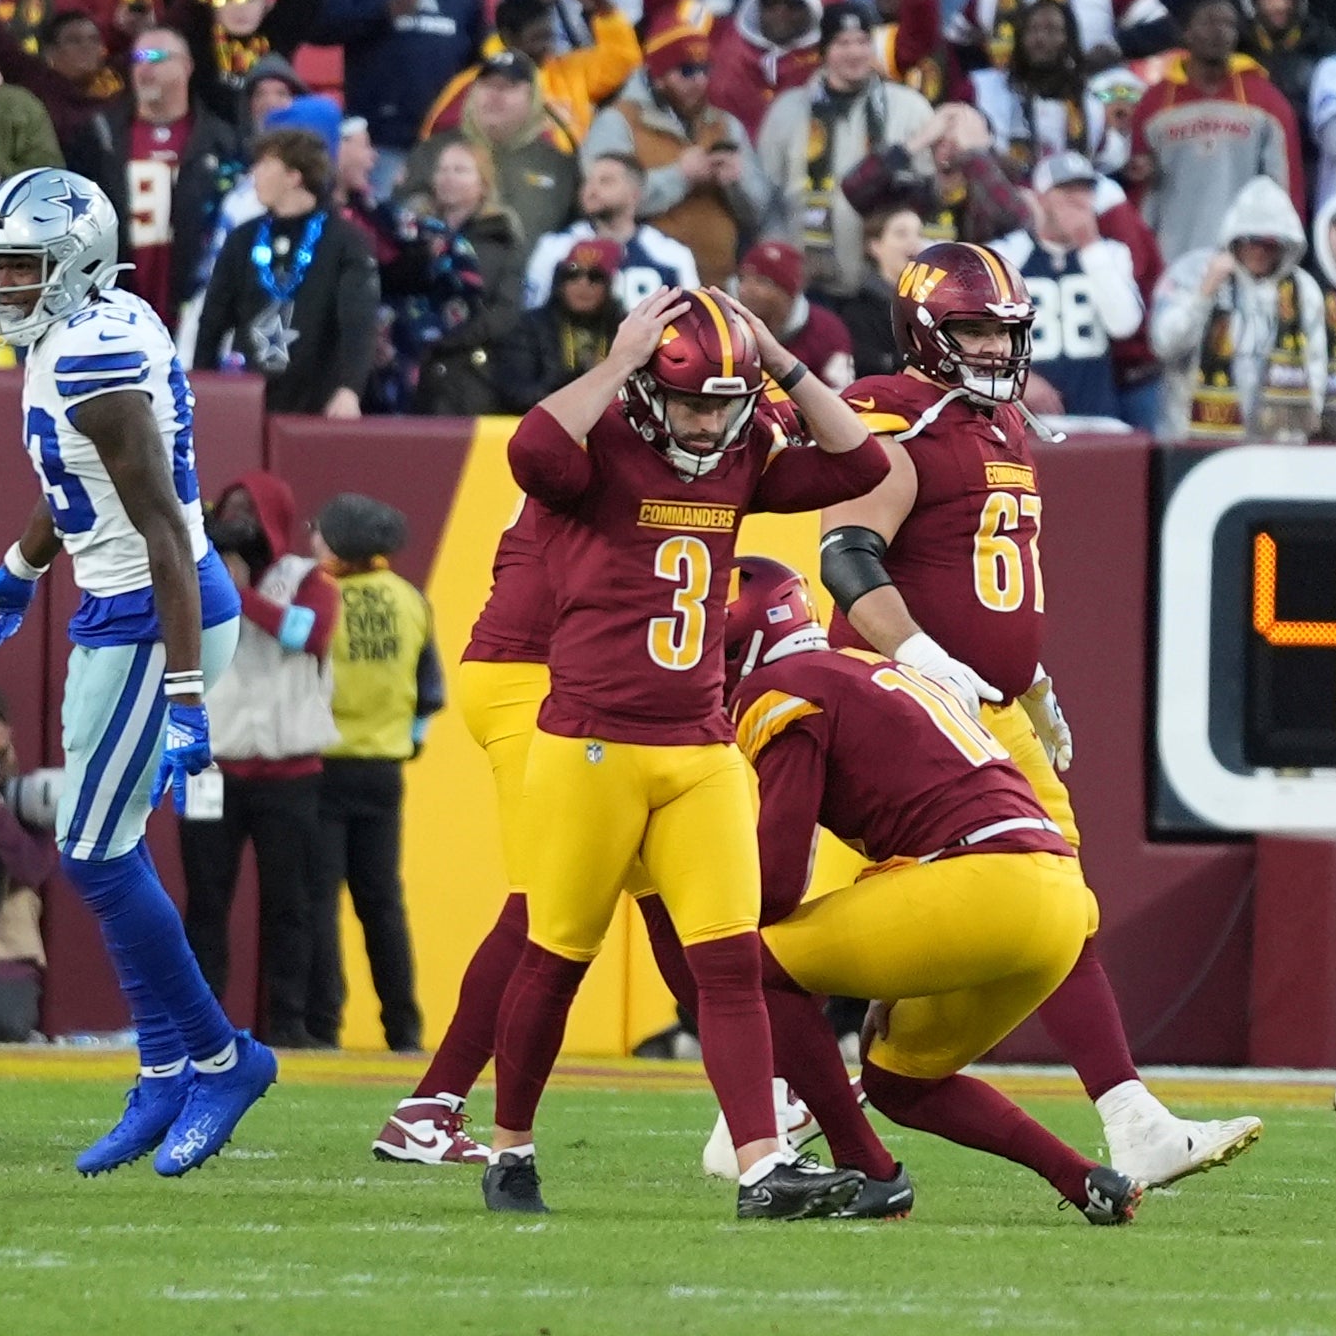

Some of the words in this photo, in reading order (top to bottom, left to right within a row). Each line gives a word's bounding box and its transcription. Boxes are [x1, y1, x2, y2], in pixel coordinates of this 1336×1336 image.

[639, 504, 737, 530] COMMANDERS
[973, 492, 1045, 614] 67
[647, 535, 712, 672] 3
